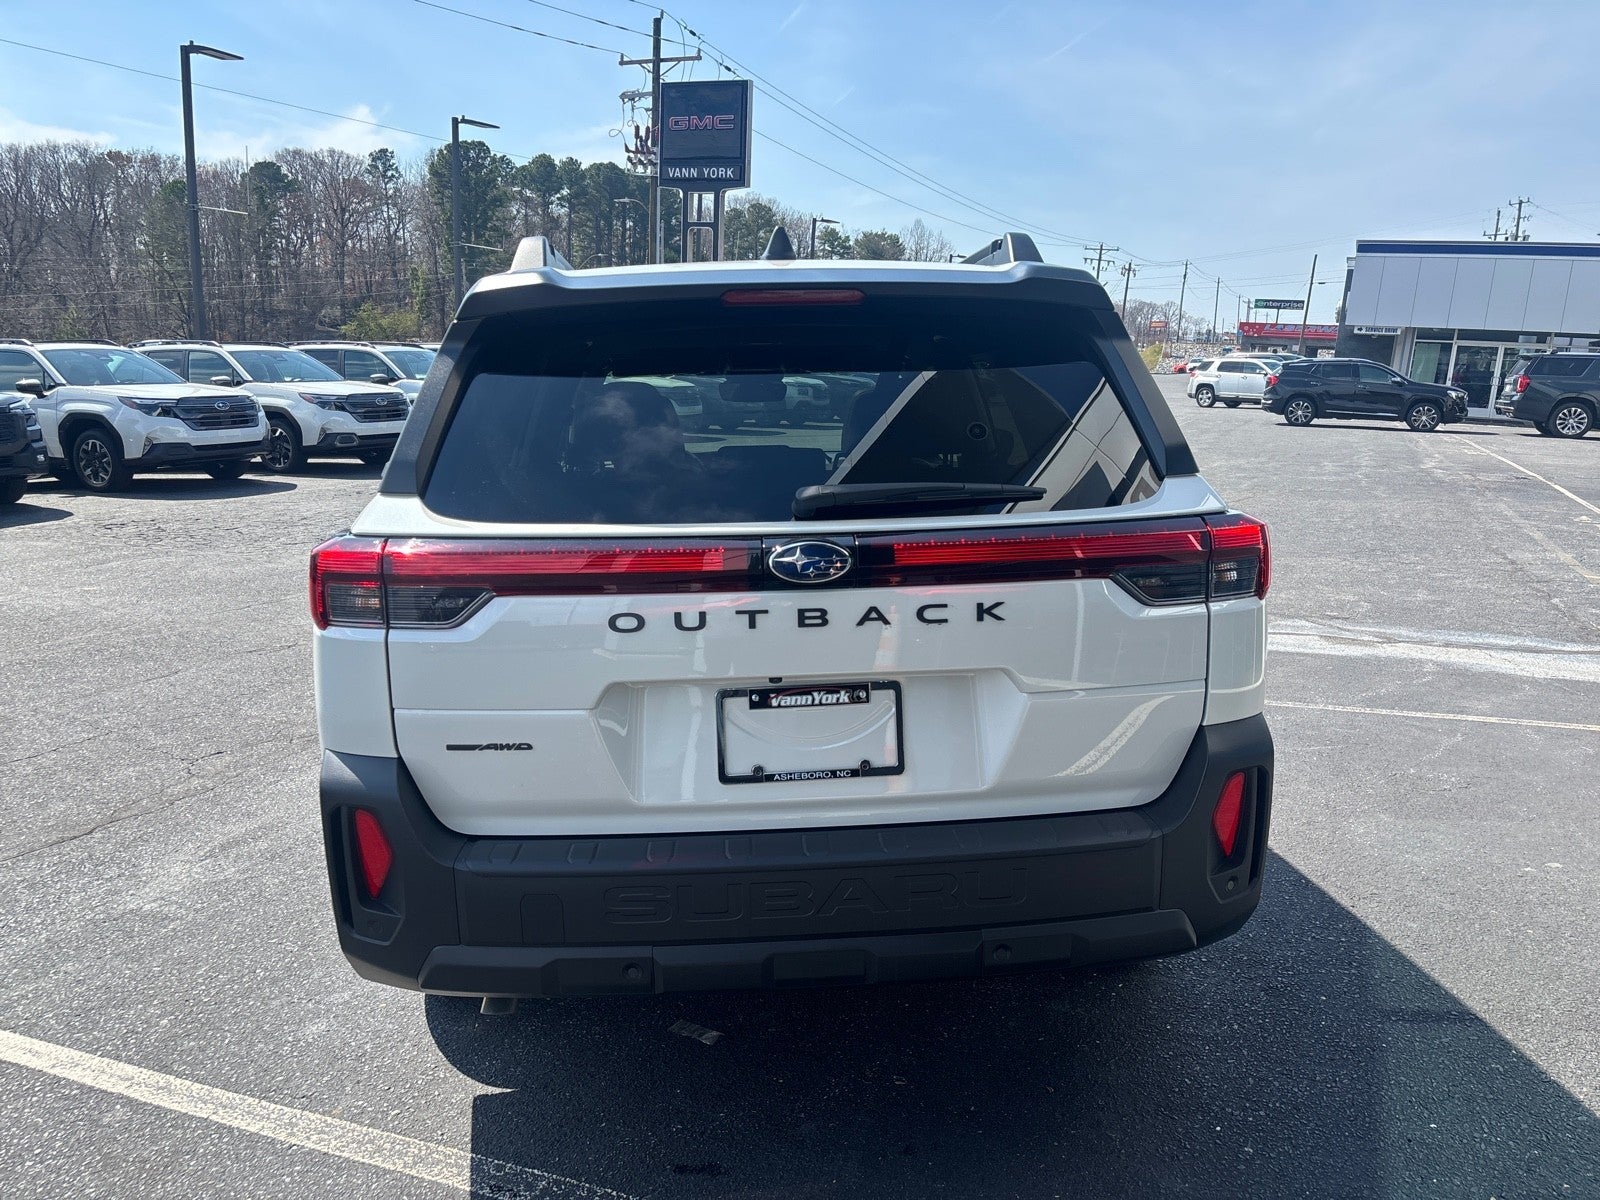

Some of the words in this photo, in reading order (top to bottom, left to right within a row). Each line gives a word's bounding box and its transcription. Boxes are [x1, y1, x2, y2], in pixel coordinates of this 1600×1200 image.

[668, 114, 735, 131] GMC
[668, 167, 698, 178] VANN
[703, 167, 735, 178] YORK
[1256, 300, 1304, 309] enterprise
[607, 601, 1006, 634] OUTBACK
[478, 742, 534, 751] AWD
[773, 771, 834, 781] ASHEBORO,
[836, 769, 852, 778] NC
[603, 867, 1028, 925] SUBARU
